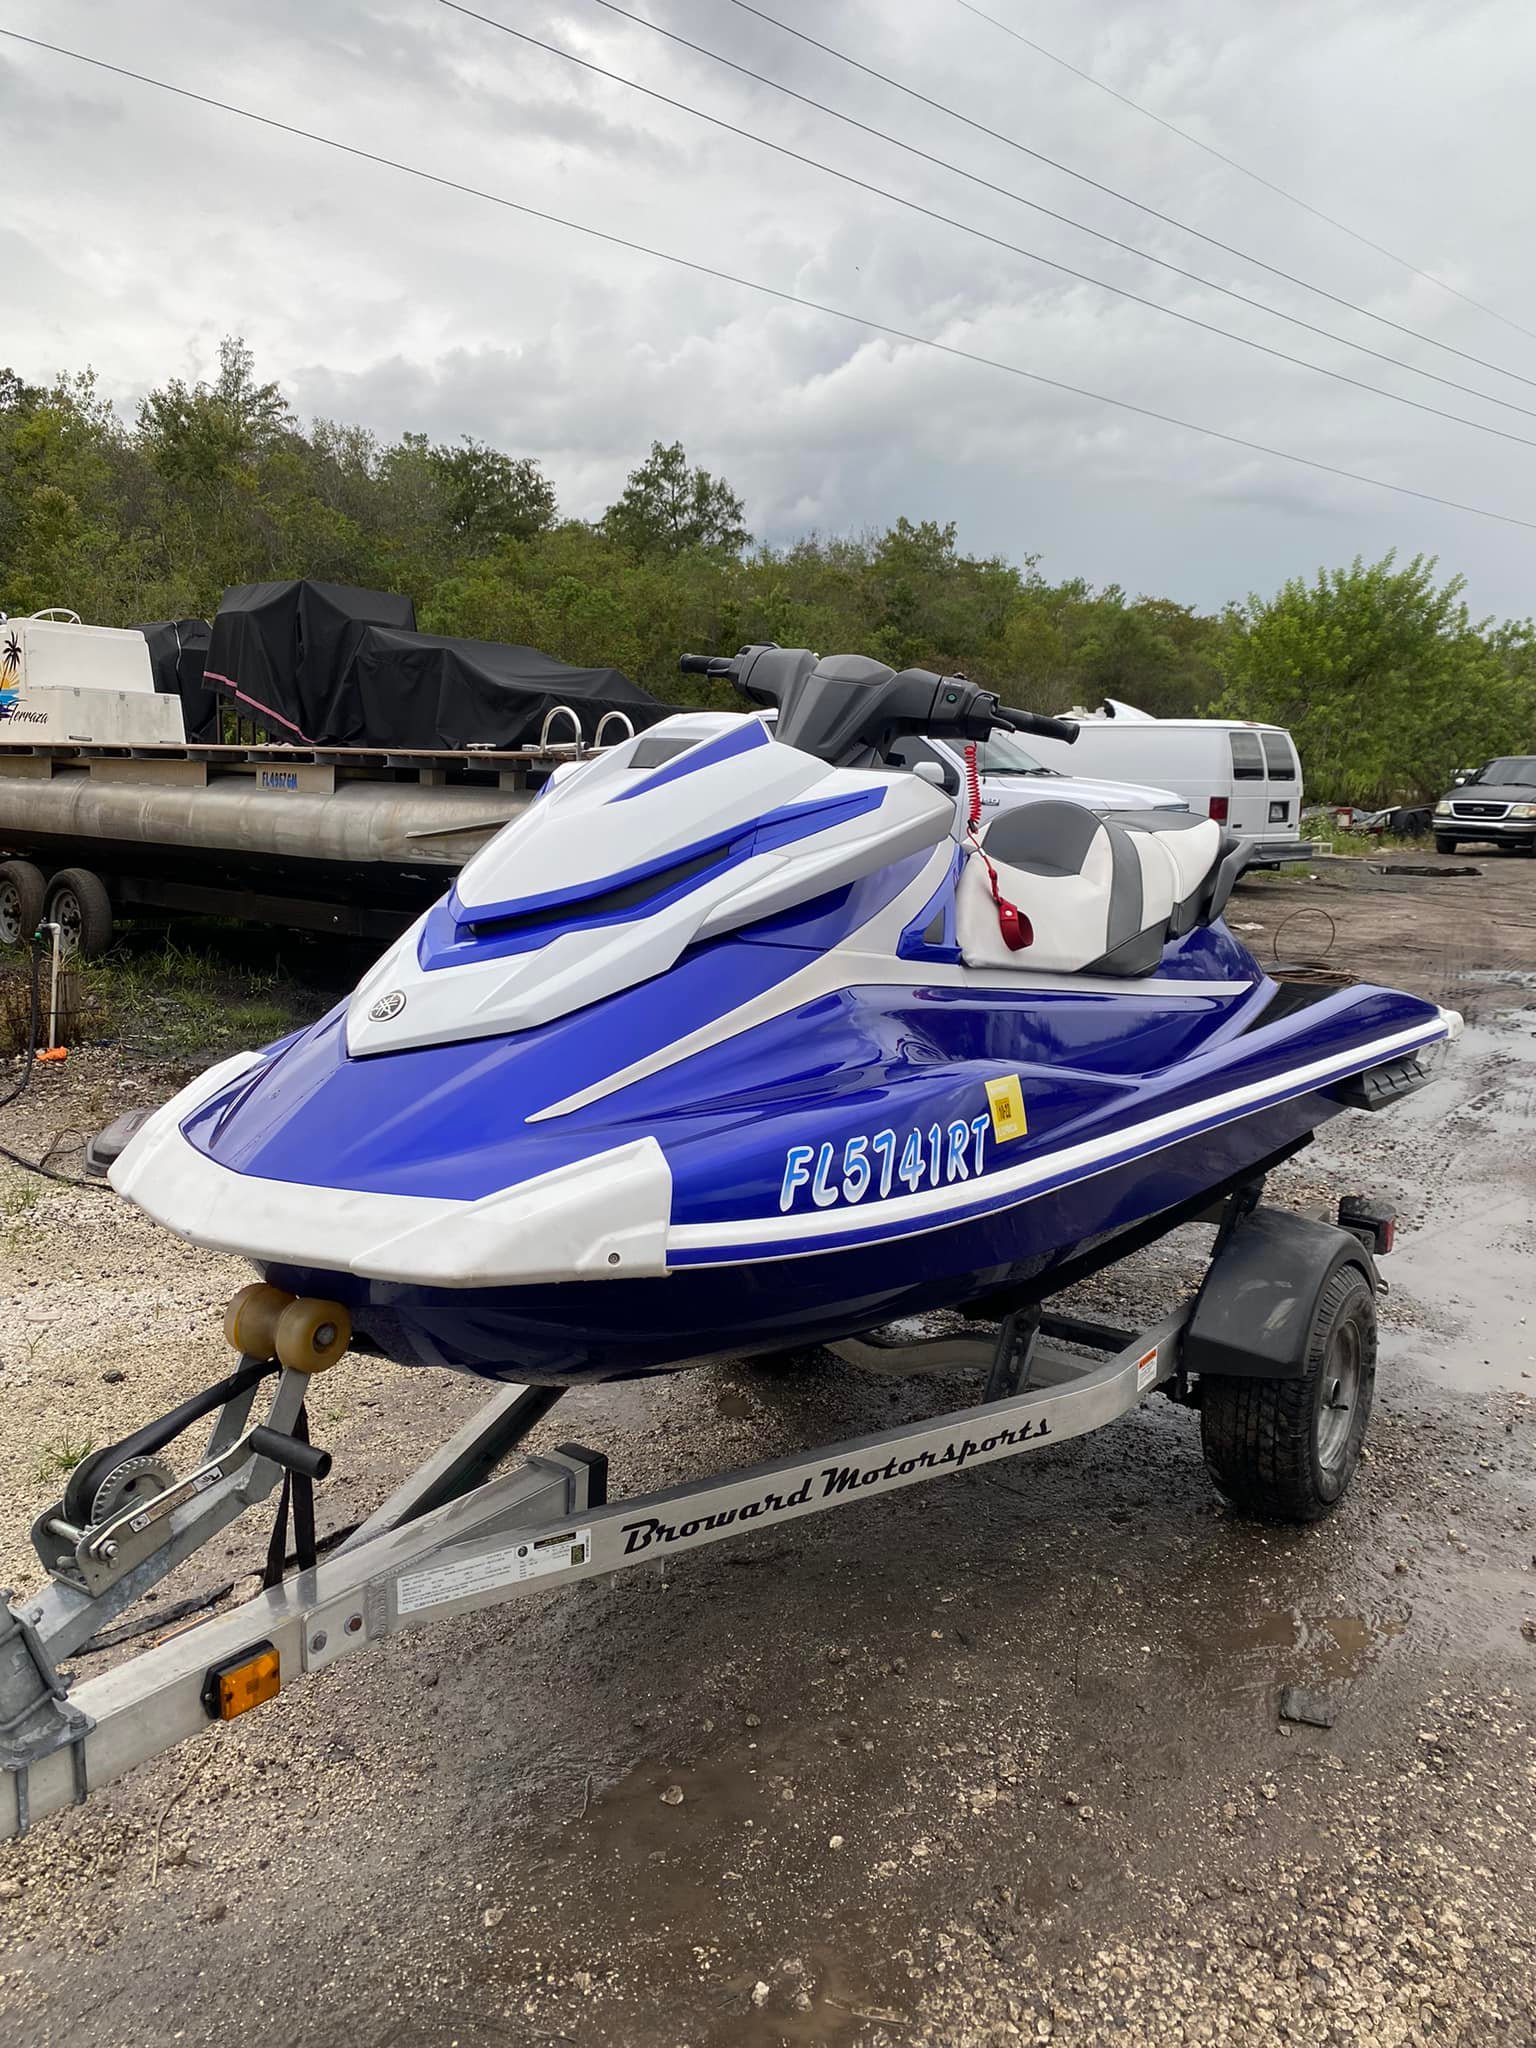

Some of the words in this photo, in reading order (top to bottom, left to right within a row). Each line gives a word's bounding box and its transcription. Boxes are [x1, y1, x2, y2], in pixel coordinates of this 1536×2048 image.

[7, 699, 48, 725] Terraza
[779, 1113, 991, 1212] FL5741RT
[621, 1478, 813, 1555] Broward
[820, 1417, 1052, 1498] Motorsports
